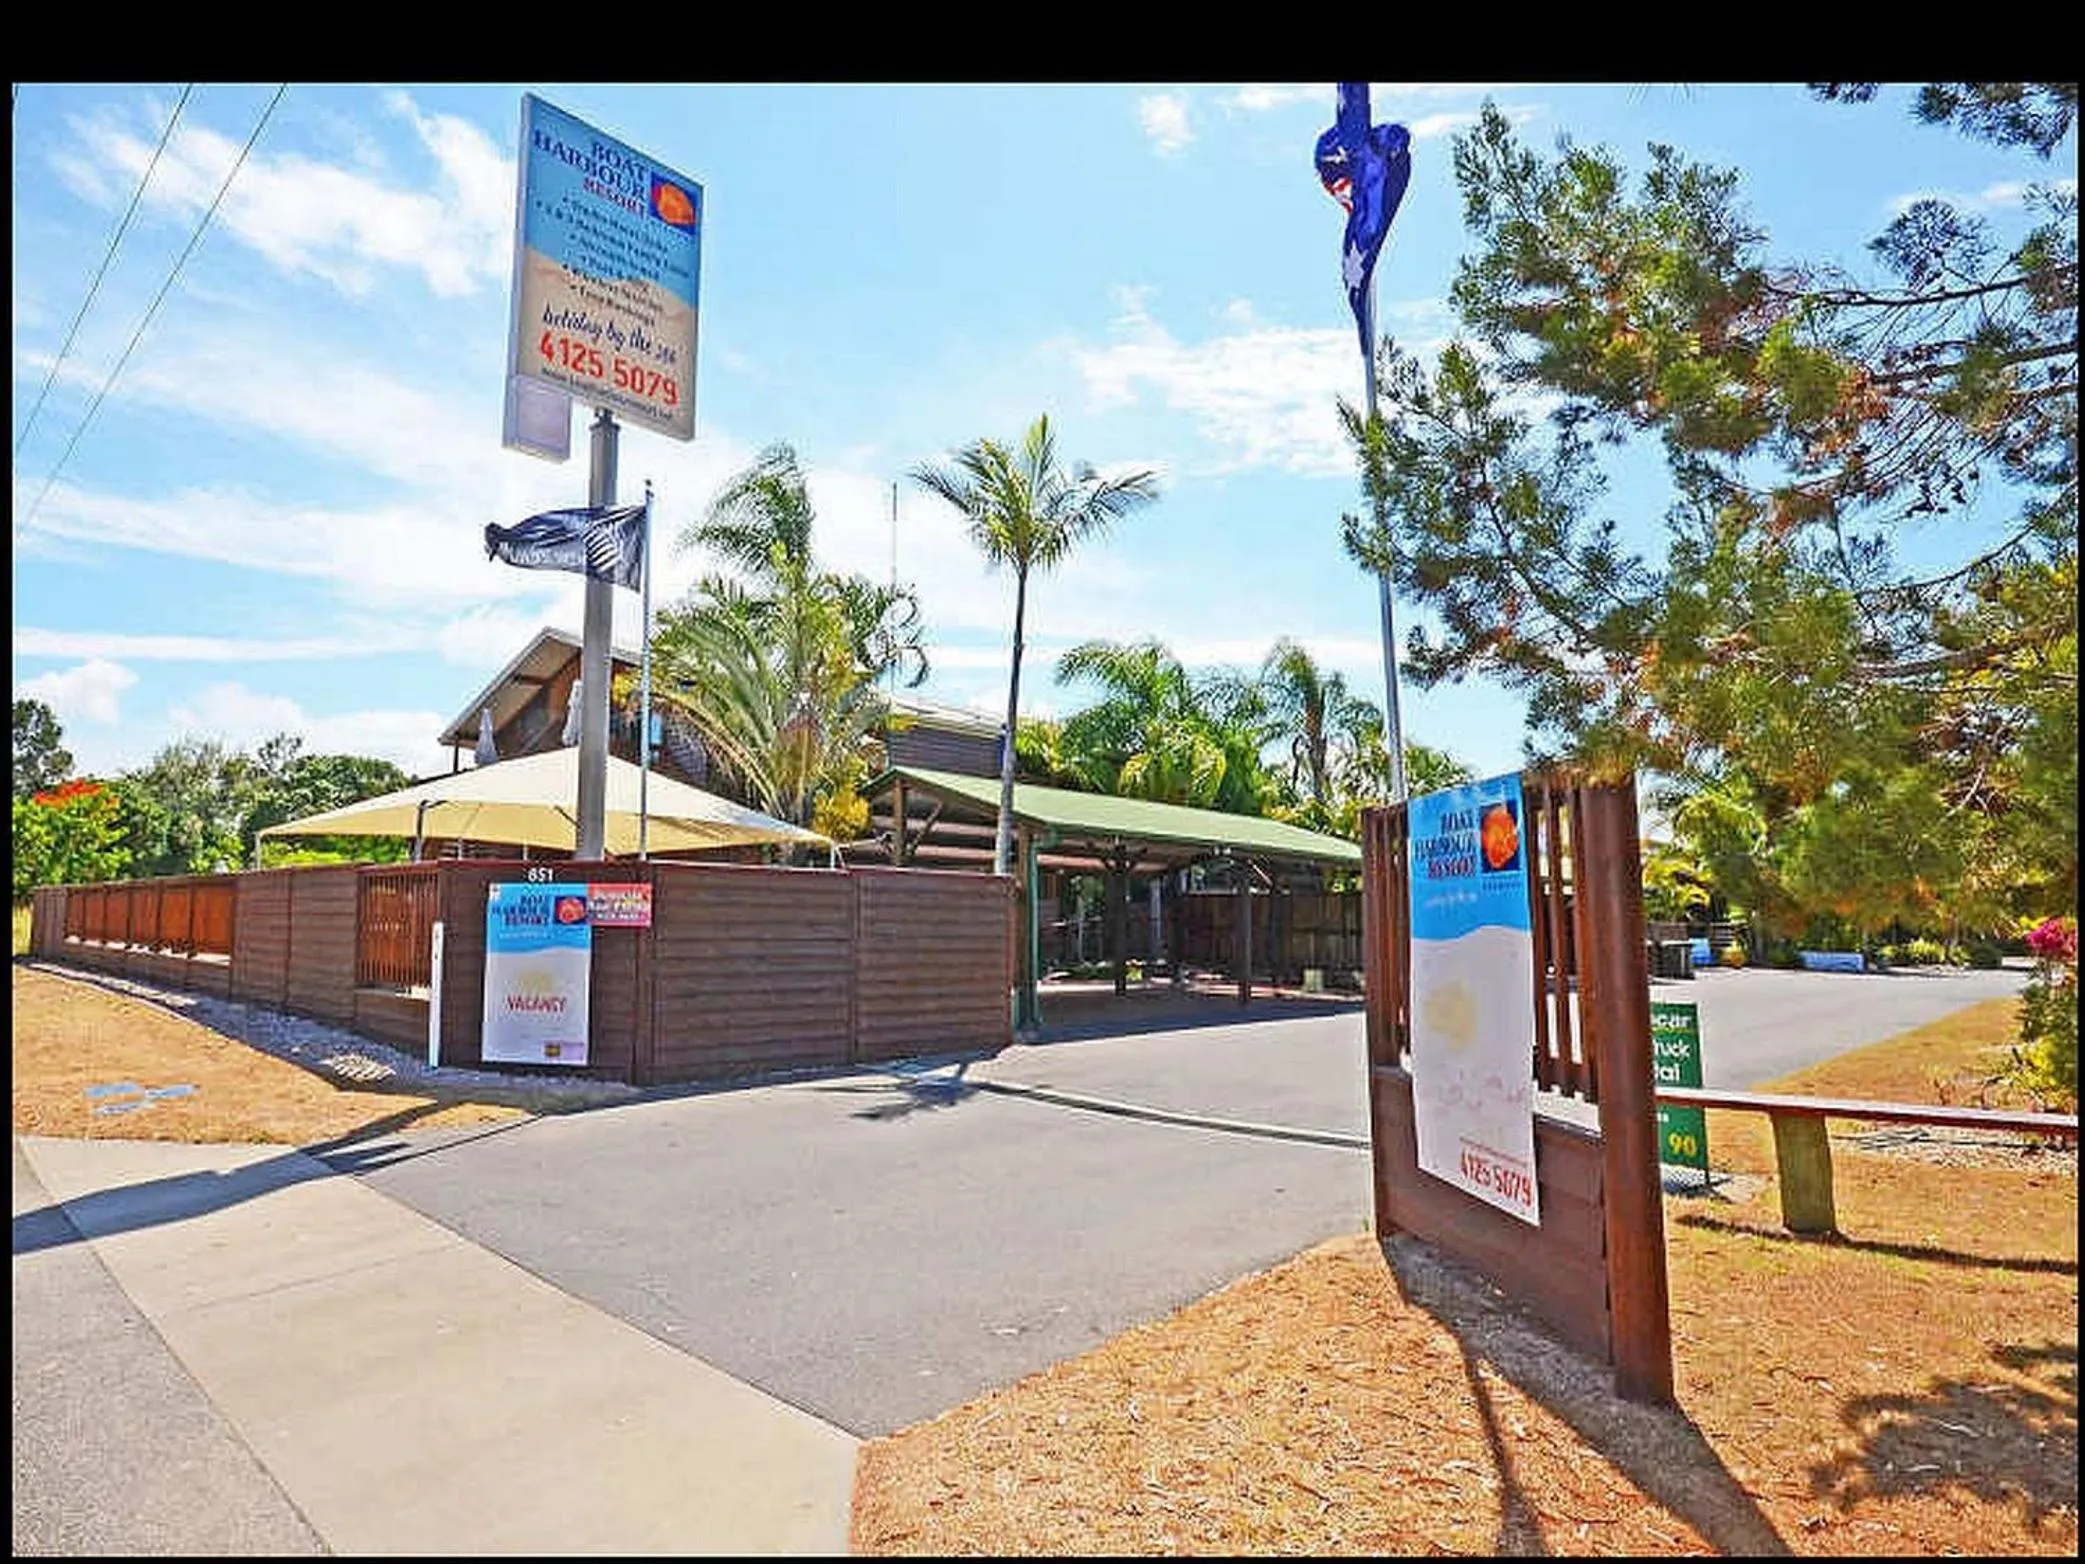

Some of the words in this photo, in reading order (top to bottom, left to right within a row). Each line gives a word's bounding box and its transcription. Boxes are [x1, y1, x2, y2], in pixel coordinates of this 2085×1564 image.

[534, 130, 645, 201] HARBOUR
[591, 142, 646, 181] BOAT
[583, 177, 645, 220] RESORT
[606, 320, 625, 352] by
[540, 331, 603, 379] 4125
[613, 358, 678, 405] 5079
[506, 994, 567, 1013] VACANCY
[1668, 1133, 1697, 1157] 90
